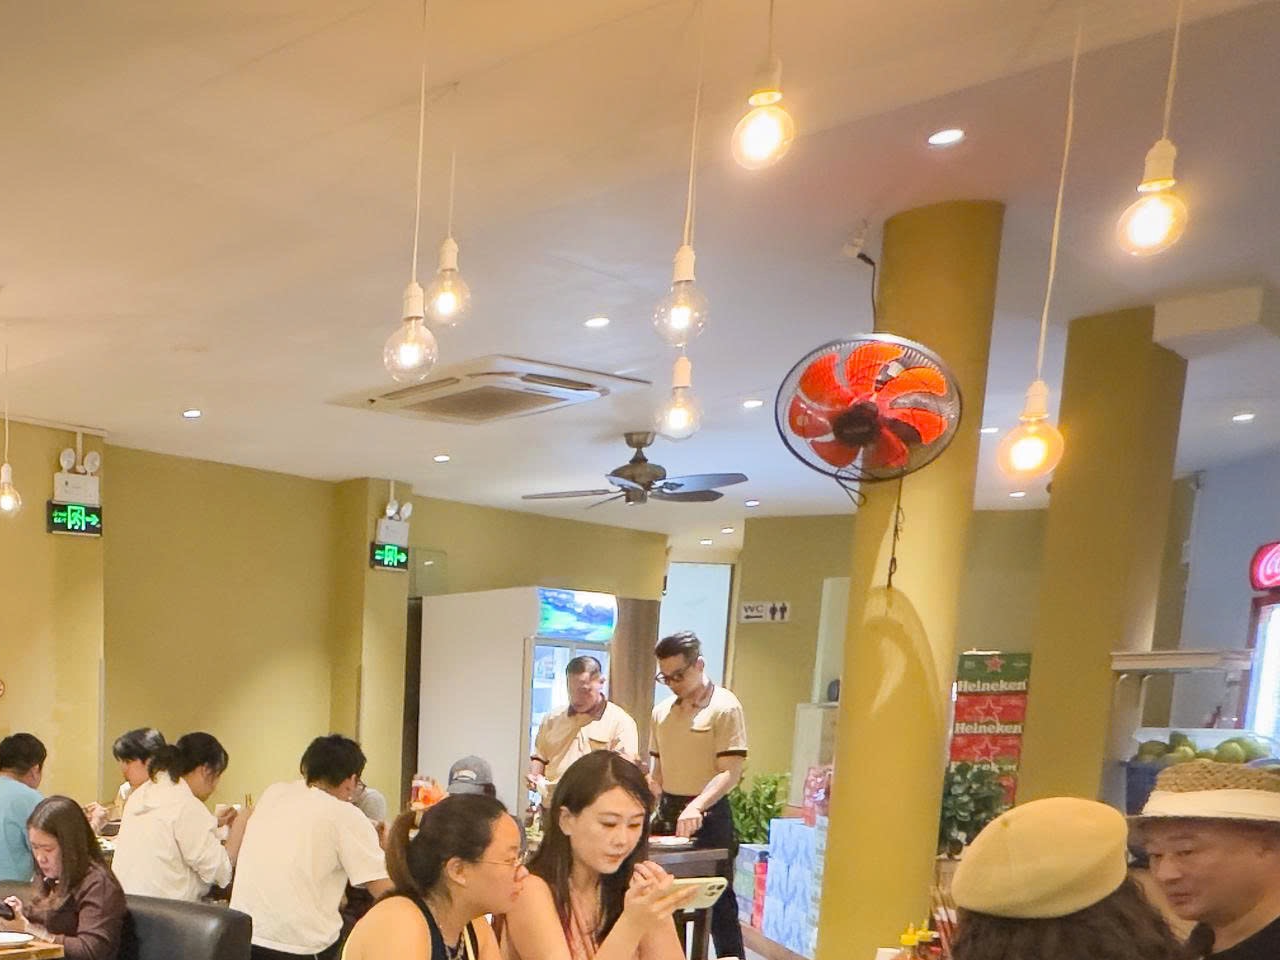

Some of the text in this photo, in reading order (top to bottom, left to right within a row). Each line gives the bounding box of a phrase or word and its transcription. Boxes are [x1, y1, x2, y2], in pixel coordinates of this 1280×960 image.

[744, 604, 764, 613] WC
[957, 679, 1027, 692] Heineken
[954, 722, 1023, 734] Heineken
